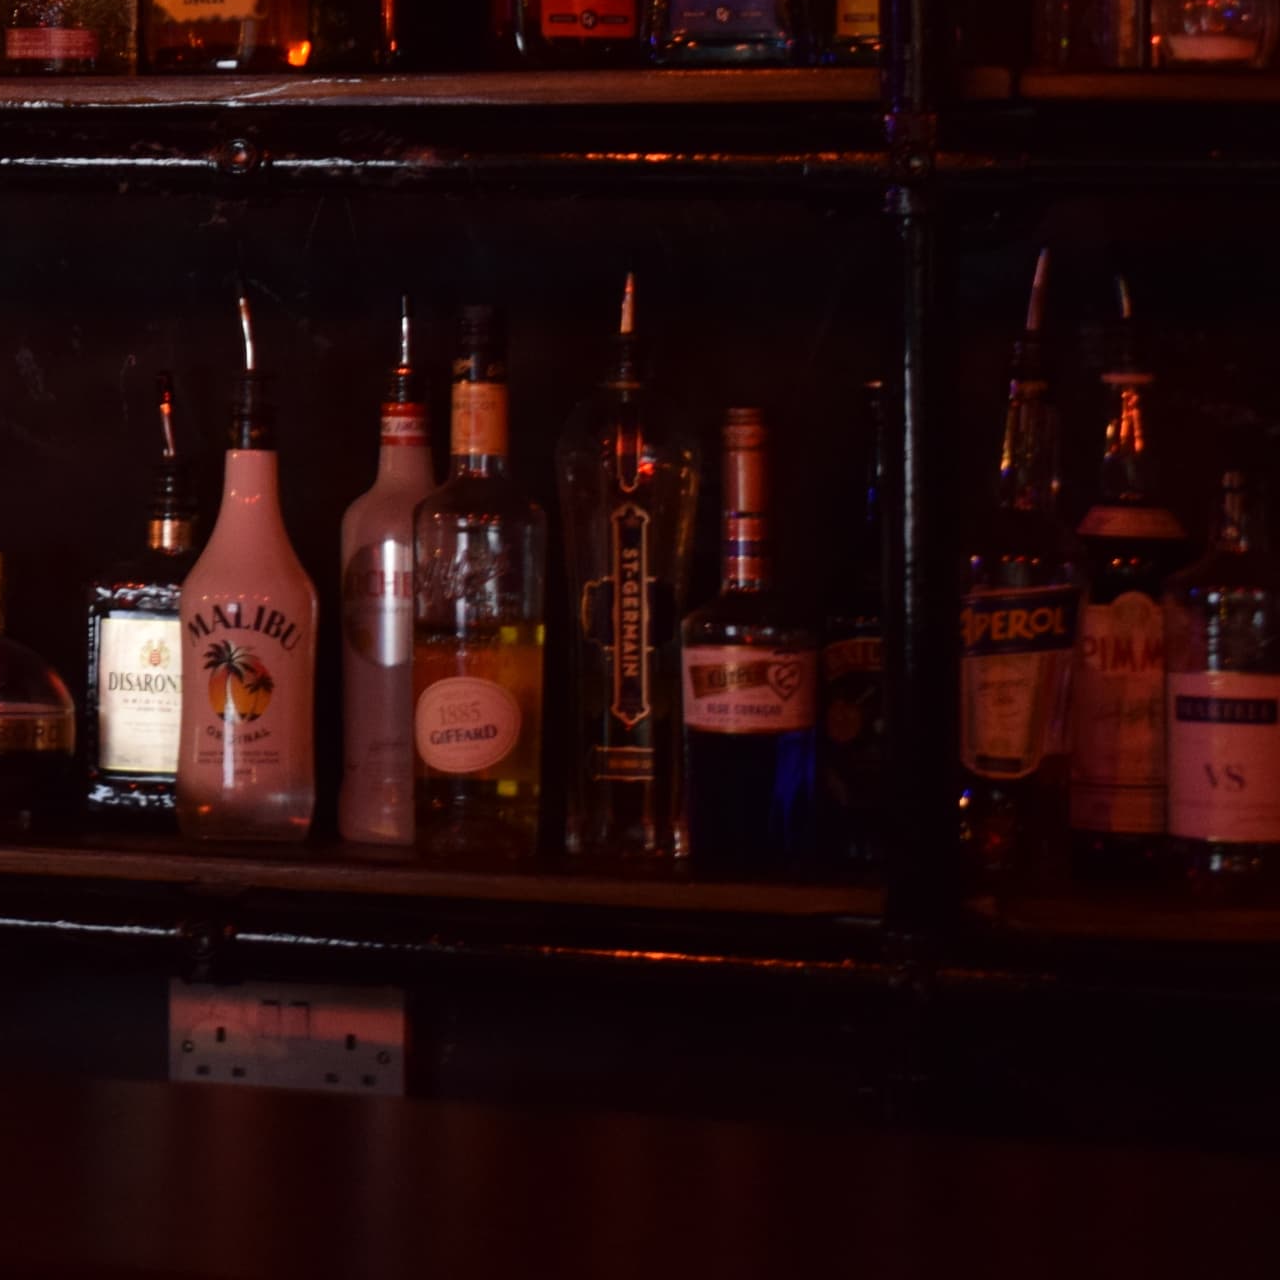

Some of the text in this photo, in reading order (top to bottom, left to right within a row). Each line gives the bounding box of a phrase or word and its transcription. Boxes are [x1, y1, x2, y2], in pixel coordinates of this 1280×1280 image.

[187, 603, 304, 652] MALIBU
[959, 606, 1066, 647] APEROL
[107, 669, 181, 695] DISARON
[429, 724, 498, 746] GIFFARD
